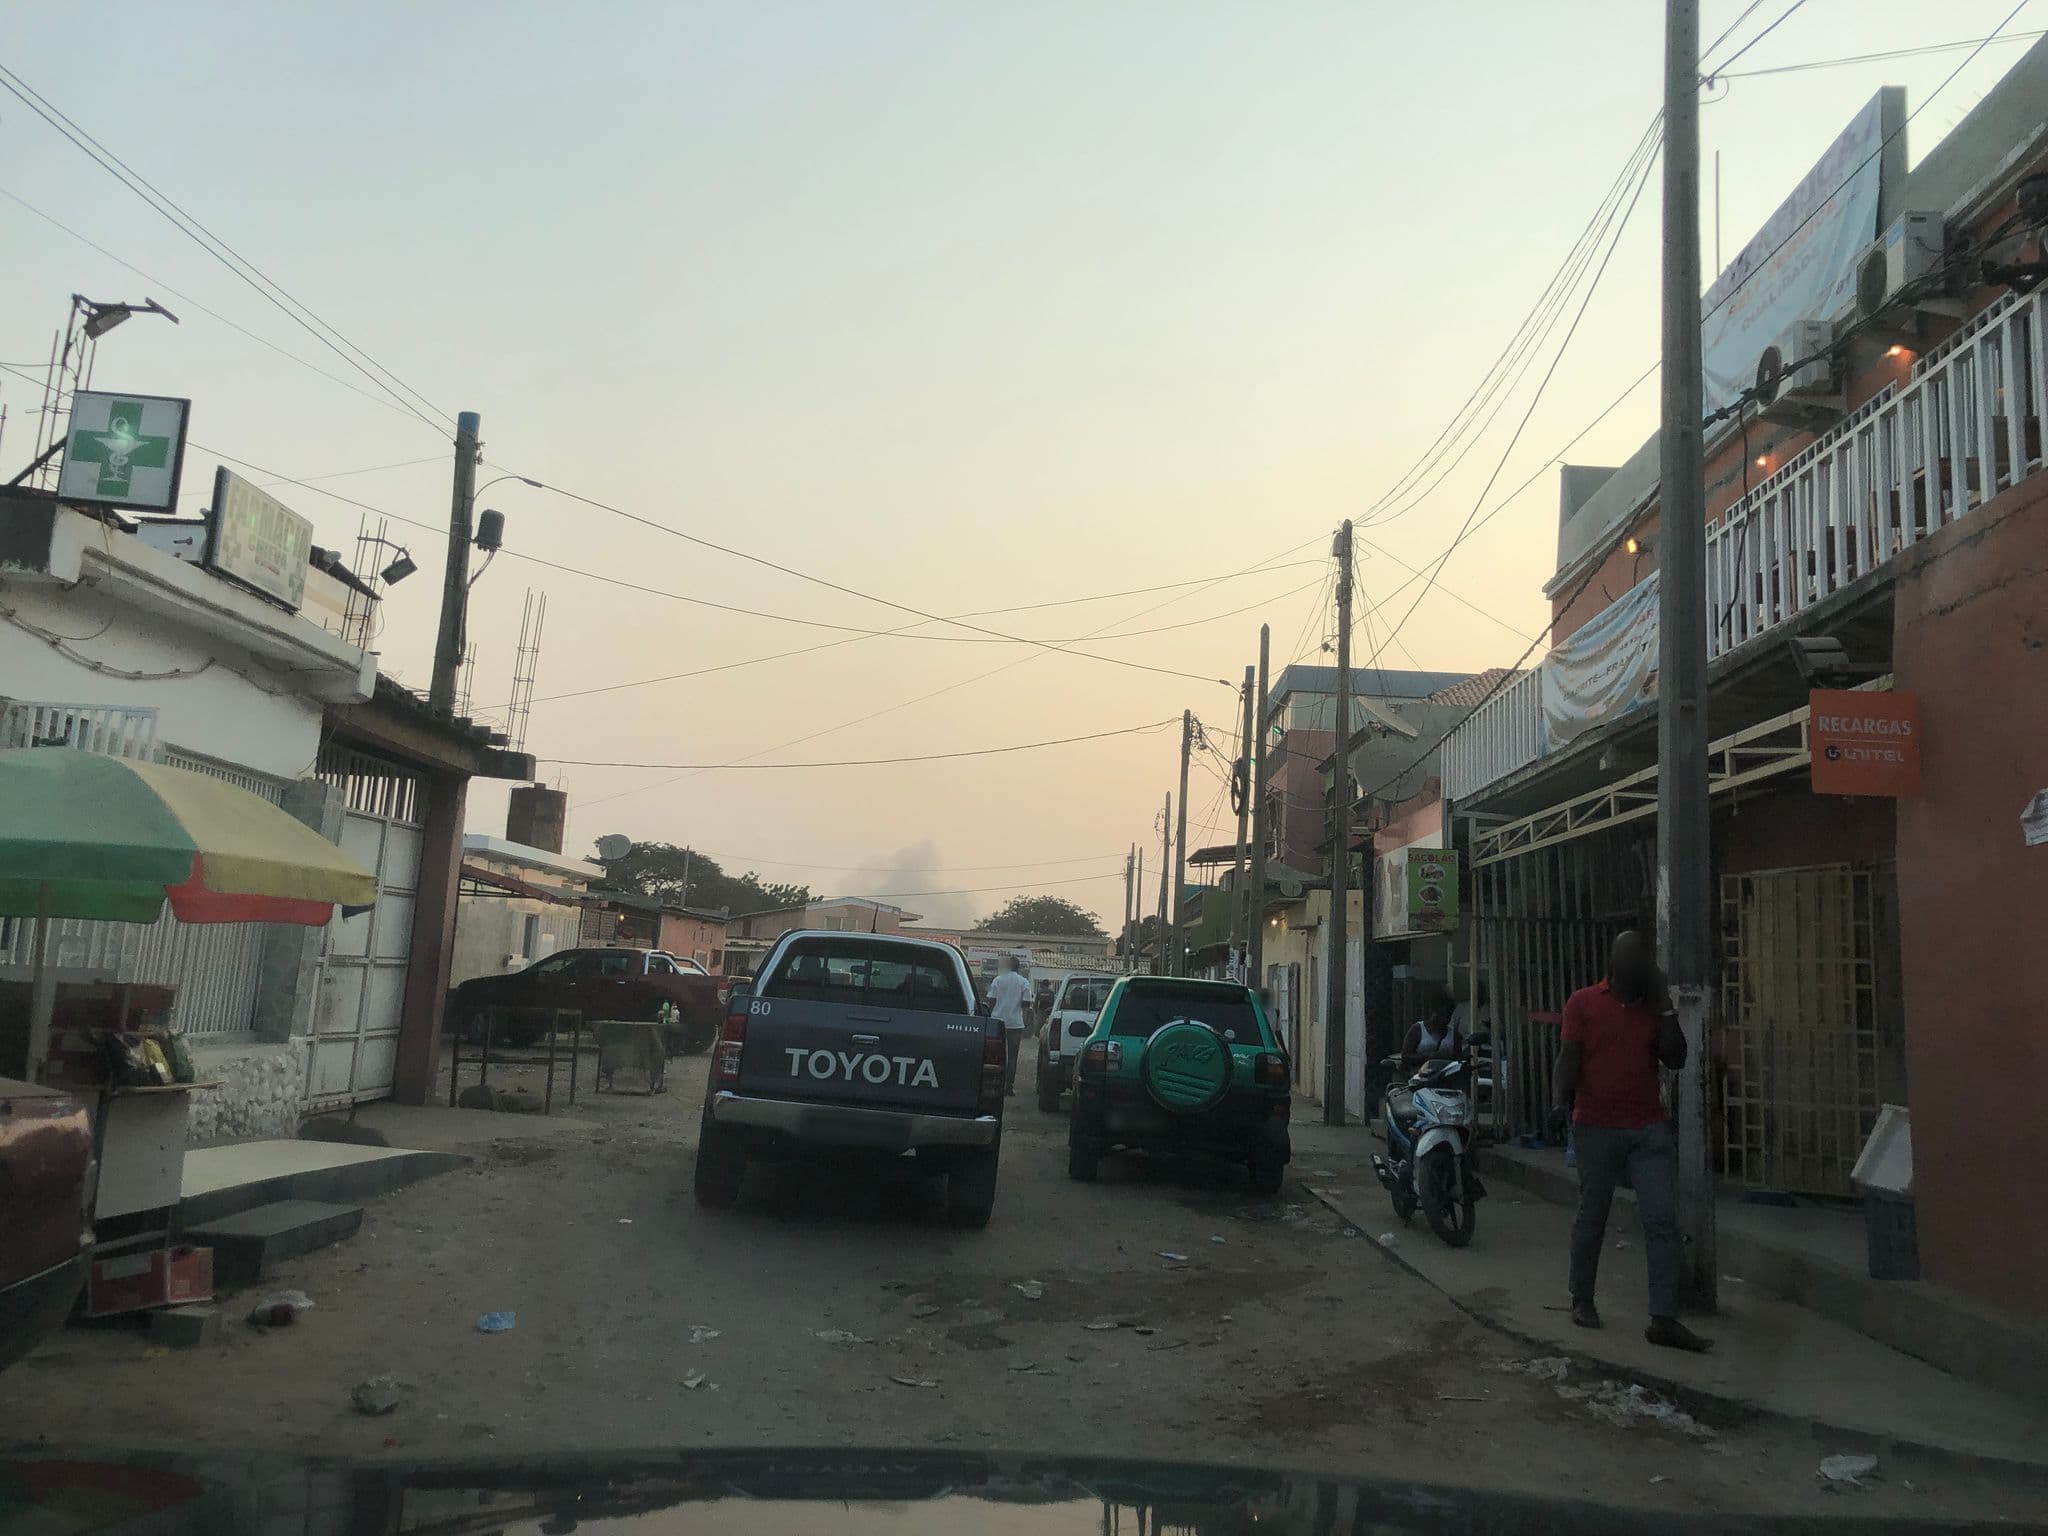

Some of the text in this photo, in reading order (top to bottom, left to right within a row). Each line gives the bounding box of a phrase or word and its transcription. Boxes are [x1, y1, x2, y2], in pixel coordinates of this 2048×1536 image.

[1818, 715, 1913, 736] RECARGAS
[750, 1000, 771, 1016] 80
[785, 1047, 939, 1088] TOYOTA
